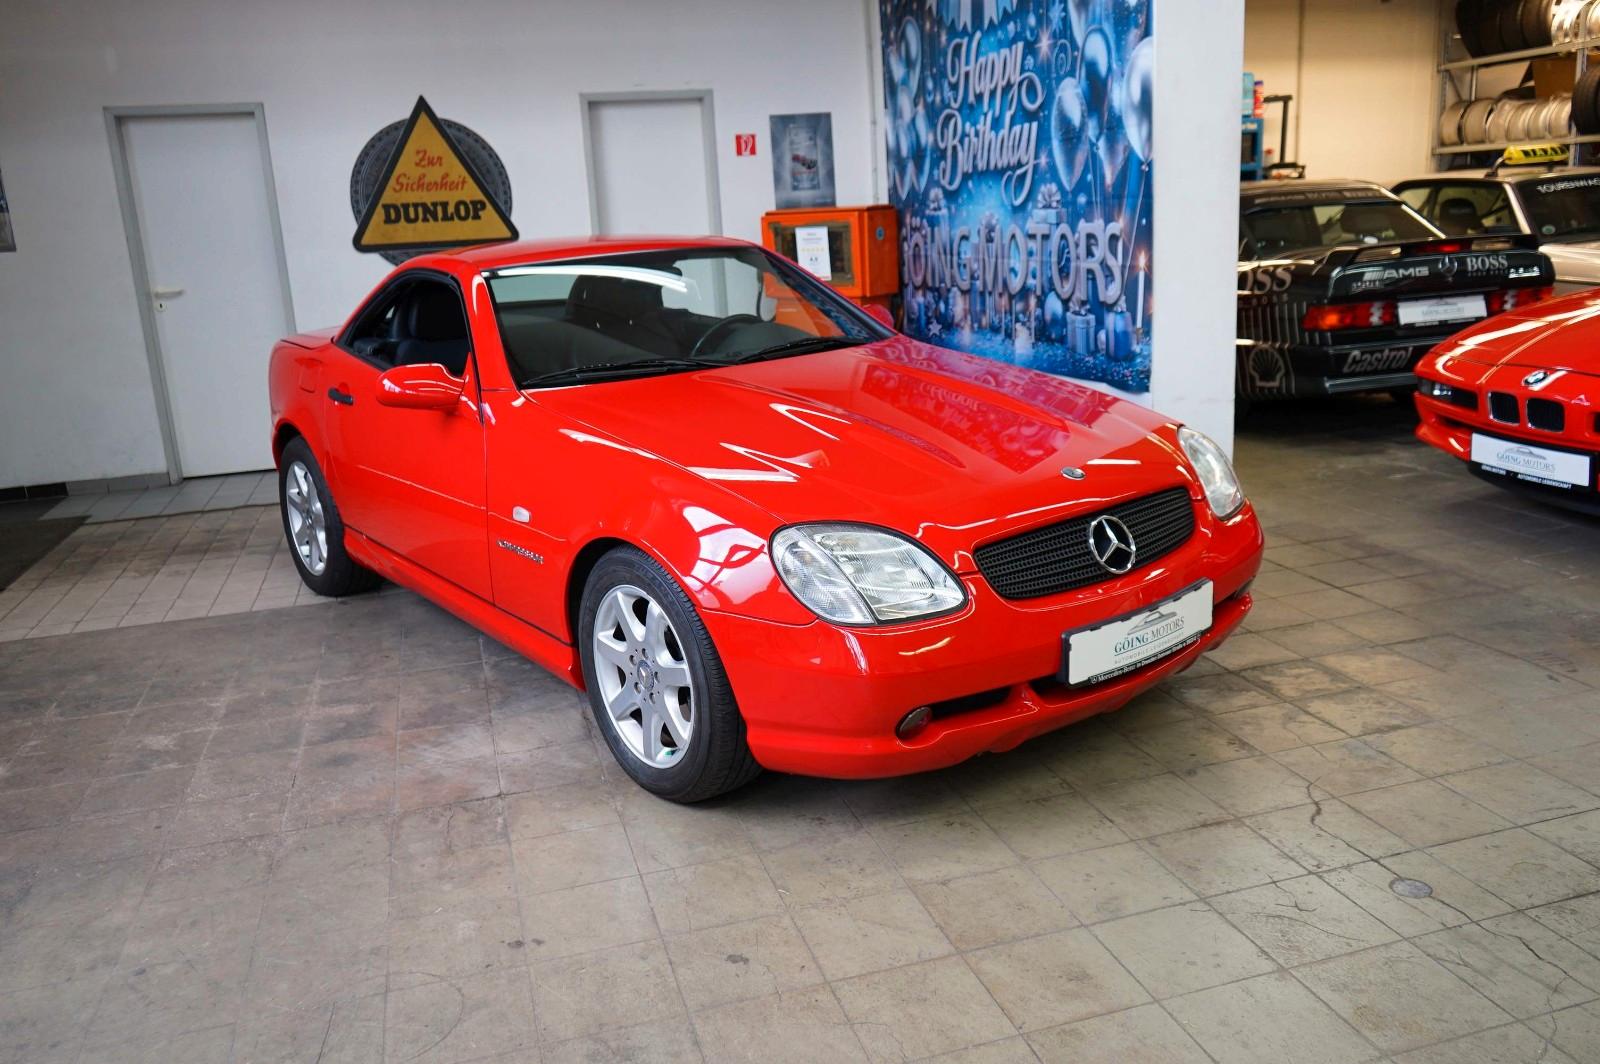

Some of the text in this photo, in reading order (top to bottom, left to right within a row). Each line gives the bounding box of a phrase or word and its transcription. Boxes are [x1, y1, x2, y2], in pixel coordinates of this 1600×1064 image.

[947, 30, 1045, 115] Happy
[414, 149, 443, 168] Zur
[937, 109, 1039, 206] Birthday
[391, 172, 468, 193] Sicherheit
[382, 200, 487, 224] DUNLOP
[903, 217, 1122, 305] ÖING MOTORS
[1384, 266, 1429, 280] AMG
[1467, 255, 1508, 271] BOSS
[1343, 346, 1413, 374] Castrol
[1114, 632, 1149, 653] GÖING
[1151, 616, 1185, 641] MOTORS
